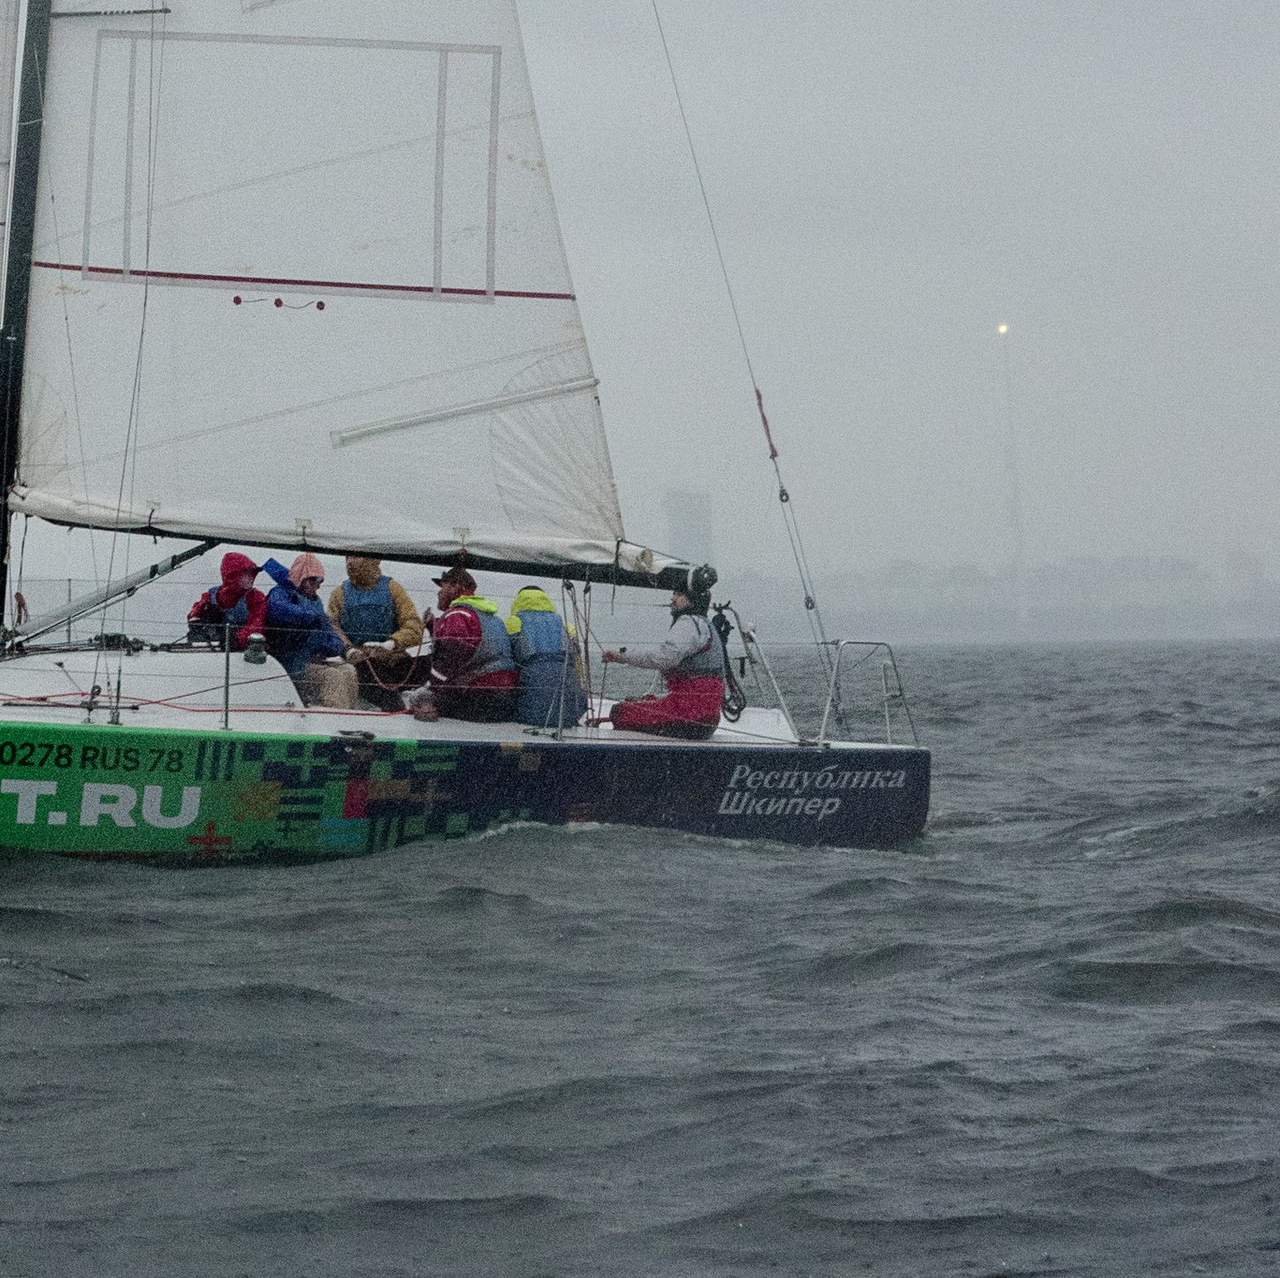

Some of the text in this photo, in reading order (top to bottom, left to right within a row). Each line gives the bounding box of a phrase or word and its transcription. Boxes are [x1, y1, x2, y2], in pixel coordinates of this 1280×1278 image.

[80, 745, 140, 772] RUS
[148, 748, 184, 773] 78
[727, 762, 906, 795] Республика
[718, 792, 841, 822] Шкипер
